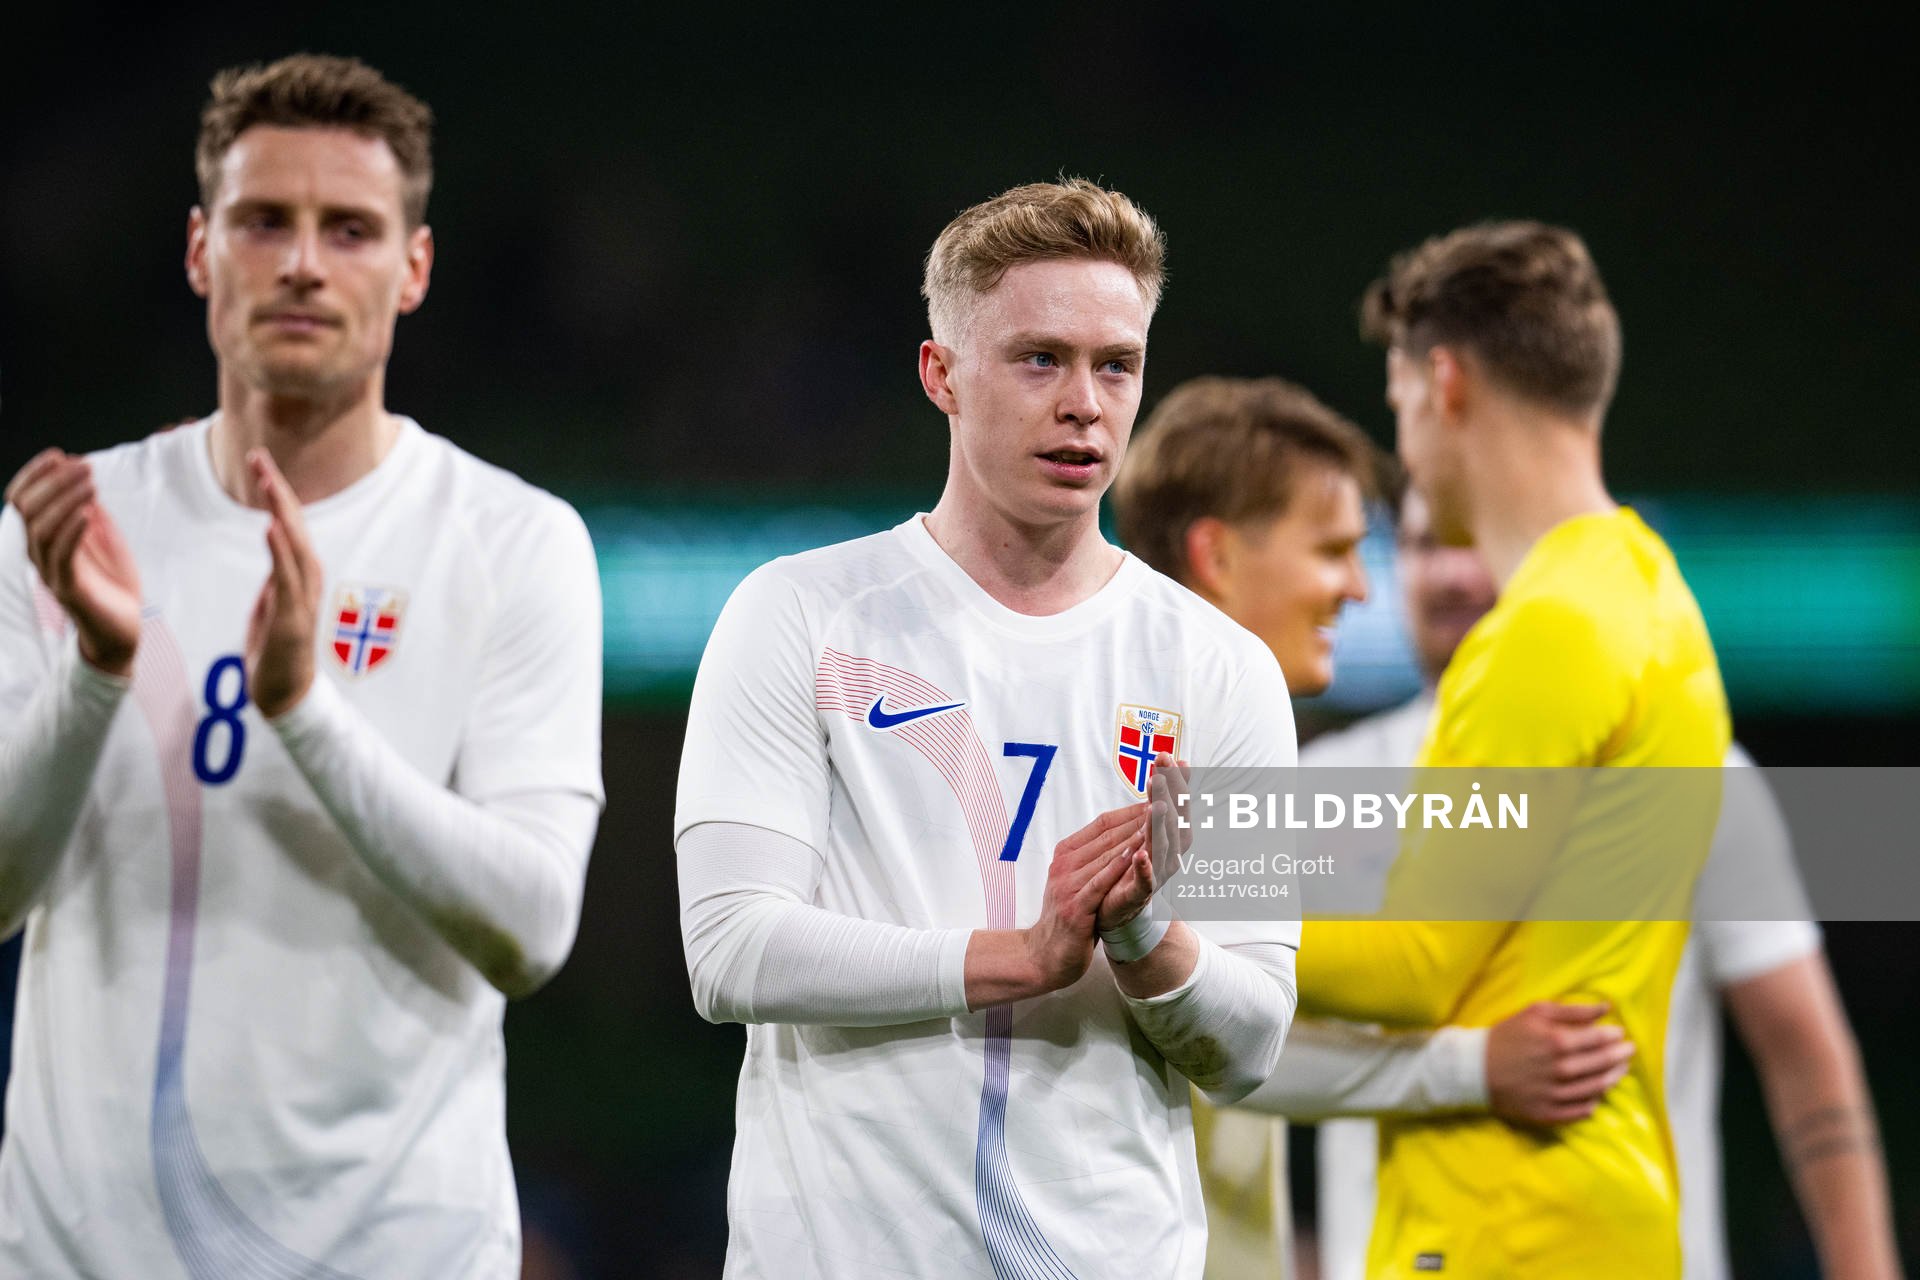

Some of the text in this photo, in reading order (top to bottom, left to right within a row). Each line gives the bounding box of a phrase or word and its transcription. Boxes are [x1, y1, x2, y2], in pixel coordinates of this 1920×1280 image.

[193, 655, 248, 784] 8
[1138, 709, 1160, 721] NORGE
[999, 742, 1058, 862] 7
